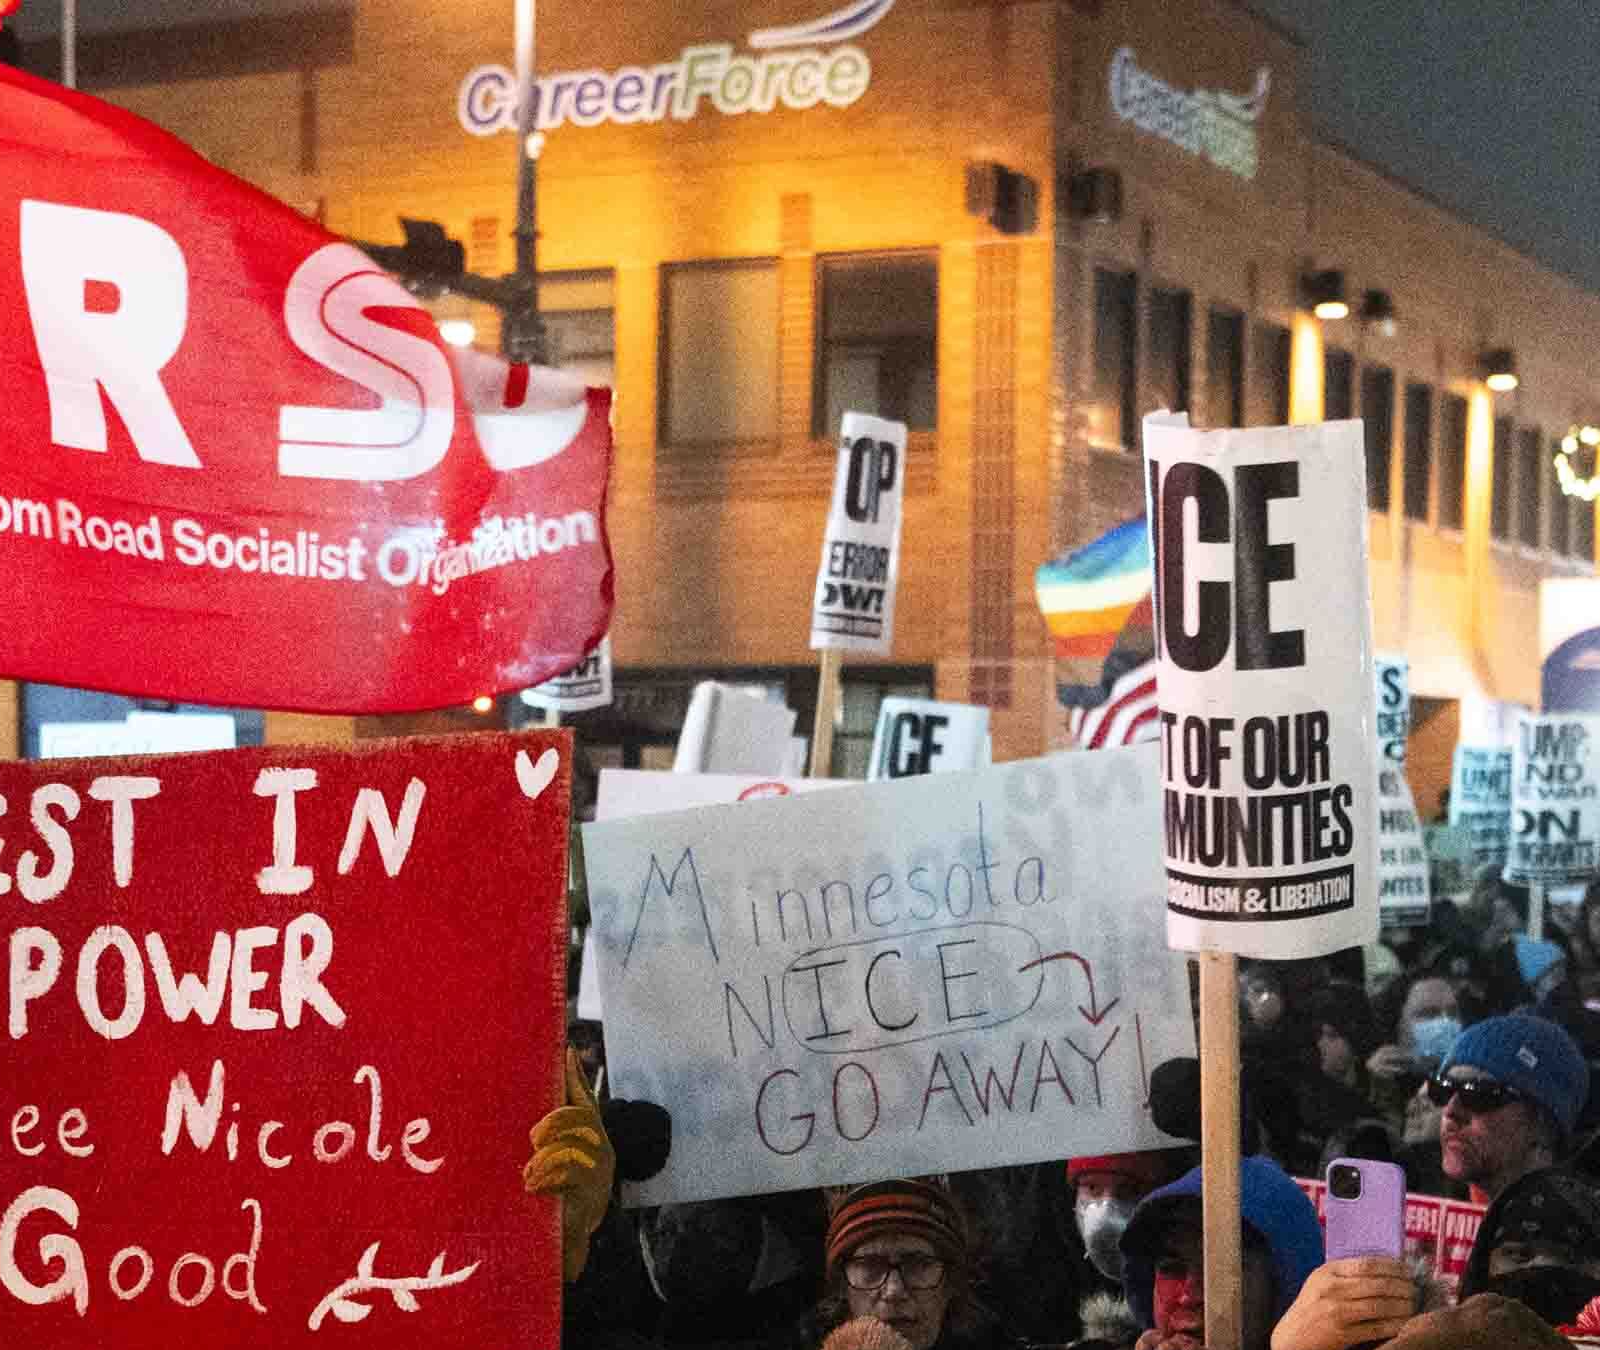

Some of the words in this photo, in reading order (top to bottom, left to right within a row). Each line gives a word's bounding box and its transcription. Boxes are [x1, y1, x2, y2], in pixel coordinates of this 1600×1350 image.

[57, 499, 164, 562] Road
[173, 518, 368, 583] Socialist
[1182, 714, 1236, 790] OF
[1242, 710, 1331, 790] OUR
[254, 767, 428, 897] IN
[623, 800, 1055, 969] Minnesota
[1243, 885, 1267, 913] &
[1269, 872, 1352, 912] LIBERATION
[8, 911, 347, 1042] POWER
[724, 937, 990, 1058] NICE
[161, 1058, 446, 1175] Nicole
[755, 1060, 880, 1156] GO
[917, 1012, 1155, 1132] AWAY!
